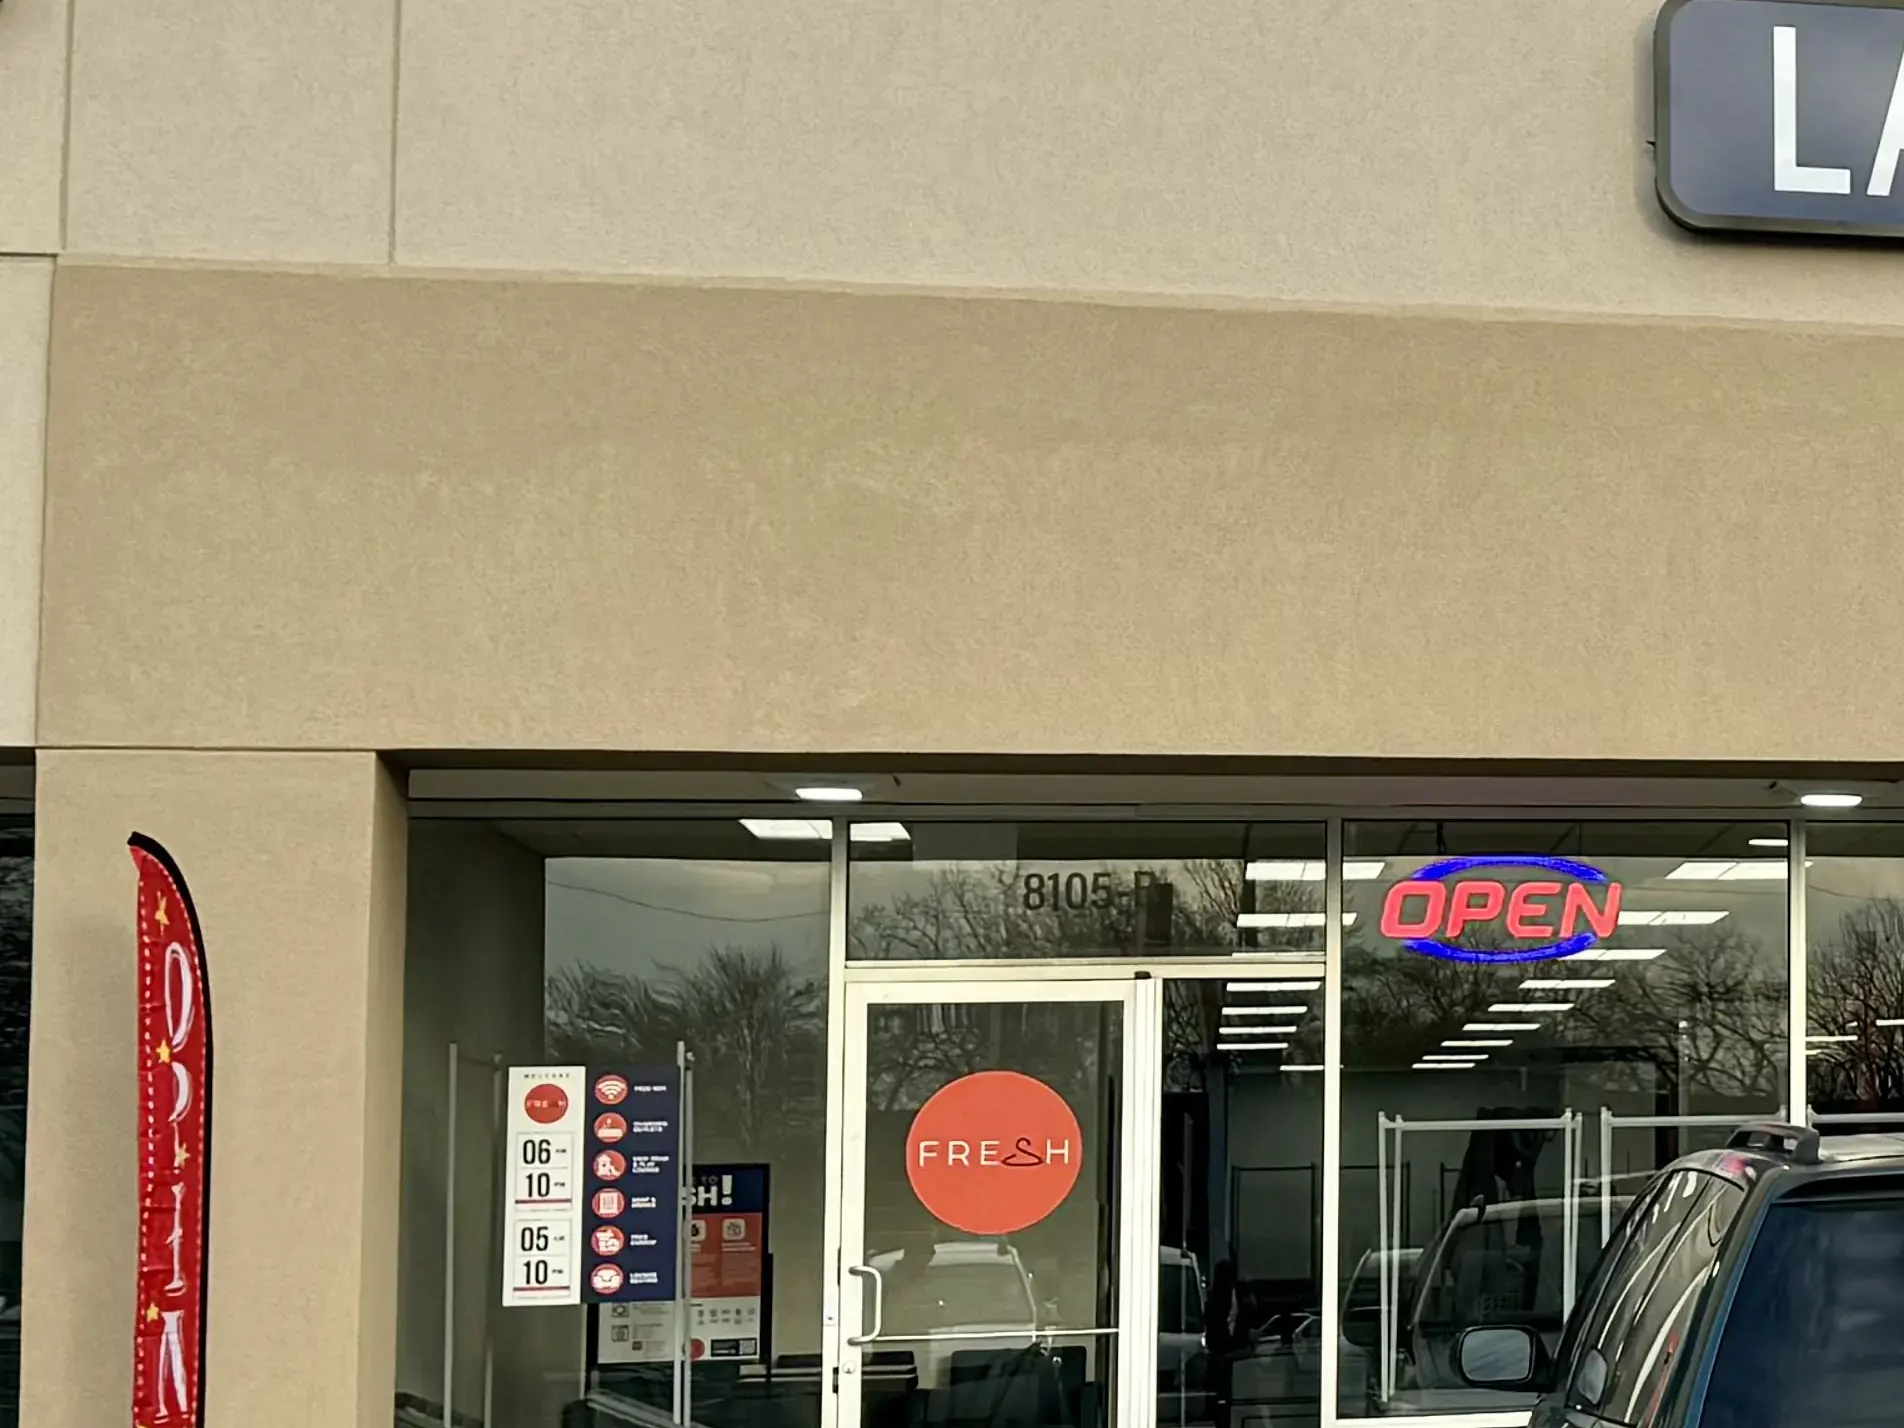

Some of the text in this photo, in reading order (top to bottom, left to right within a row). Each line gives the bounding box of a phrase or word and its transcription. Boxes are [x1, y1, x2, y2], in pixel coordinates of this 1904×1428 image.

[1379, 879, 1623, 939] OPEN
[522, 1139, 551, 1164] 06
[919, 1137, 1069, 1168] FRESH
[525, 1172, 550, 1197] 10
[520, 1226, 549, 1252] 05
[523, 1259, 548, 1285] 10
